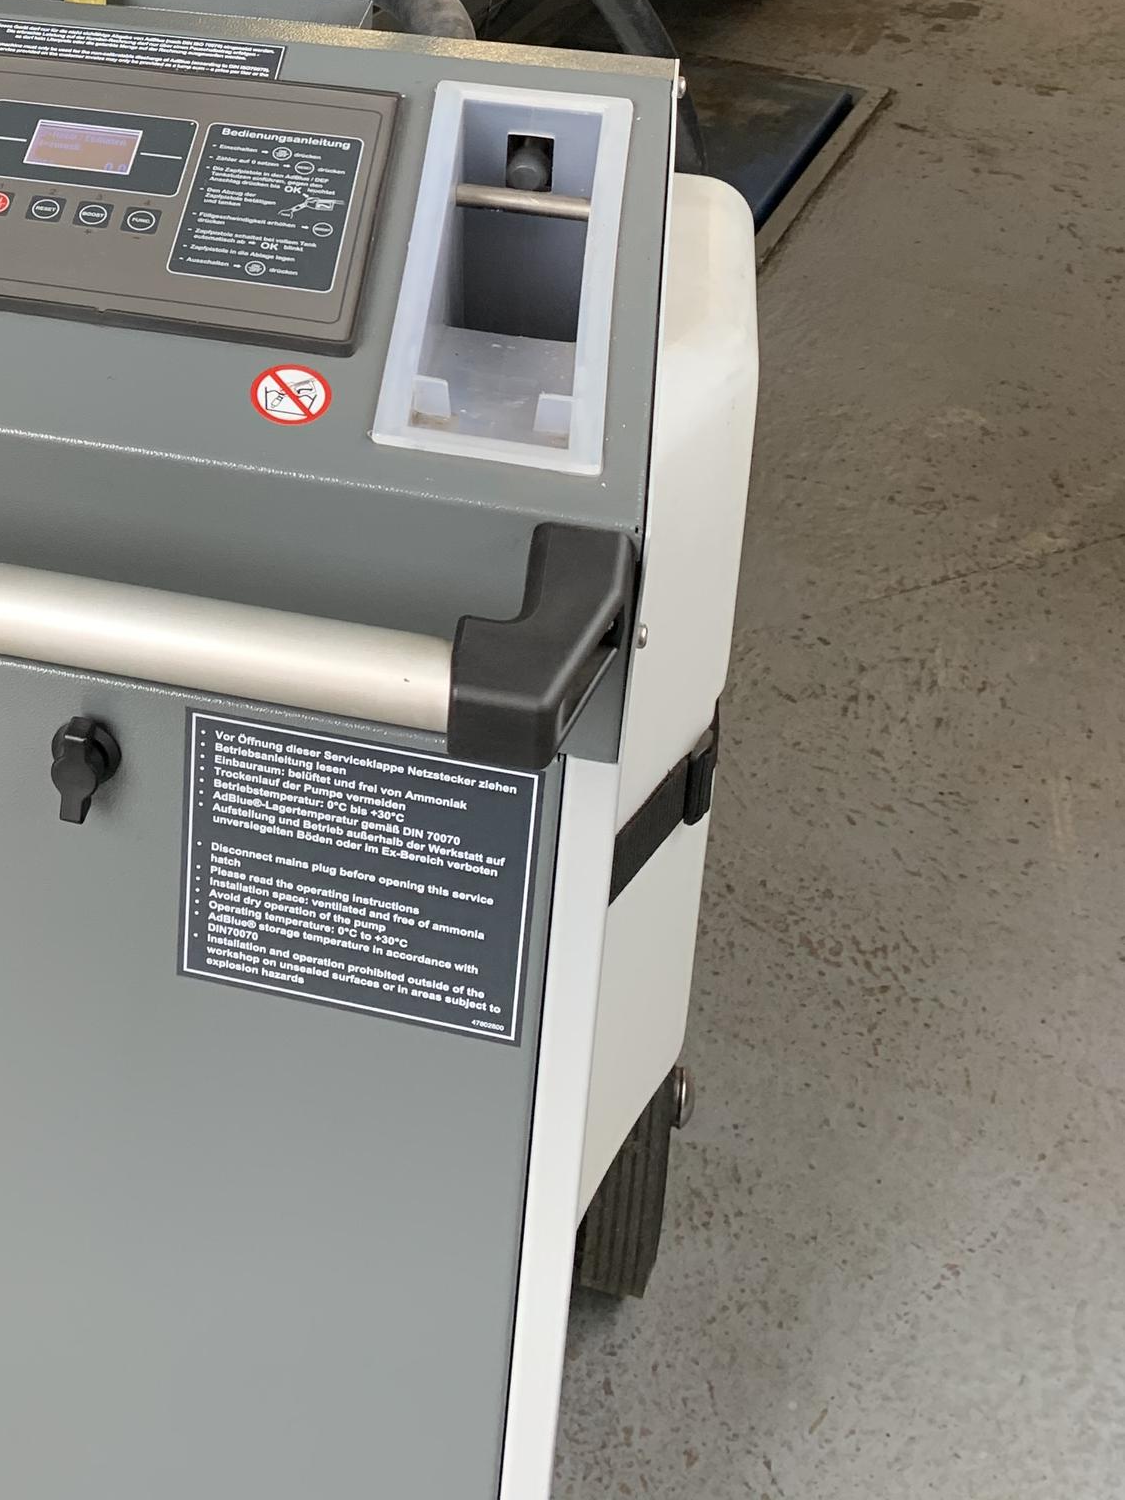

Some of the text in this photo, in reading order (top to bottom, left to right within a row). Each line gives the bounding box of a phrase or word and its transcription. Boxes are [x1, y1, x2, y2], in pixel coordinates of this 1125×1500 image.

[220, 127, 351, 150] Bedienungsanleitung
[214, 754, 467, 810] Einbauraum: belüftet und frei von Ammoniak
[215, 742, 346, 775] Betriebsanleitung lesen
[215, 729, 517, 794] Vor Öffnung dieser Serviceklappe Netzstecker ziehen
[213, 766, 405, 811] Trockenlauf der Pumpe vermeiden
[213, 778, 323, 809] Betriebstemperatur:
[350, 804, 367, 816] bis
[212, 801, 505, 867] Aufstellung und Betrieb außerhalb der Werkstatt auf
[212, 812, 498, 877] unversiegelten Böden oder im Ex-Bereich verboten
[361, 818, 399, 836] gemäß
[402, 826, 423, 838] DIN
[426, 830, 460, 846] 70070
[210, 853, 240, 867] hatch
[211, 841, 493, 905] Disconnect mains plug before opening this service
[208, 887, 386, 934] Avoid dry operation of the pump
[209, 876, 484, 940] Installation space: ventilated and free of ammonia
[210, 864, 419, 915] Please read the operating instructions
[207, 922, 258, 941] DIN70070
[208, 899, 262, 920] Operating
[264, 911, 334, 935] temperature:
[359, 930, 371, 941] to
[206, 955, 304, 984] explosion hazards
[207, 933, 484, 999] Installation and operation prohibited outside of the
[258, 921, 300, 939] storage
[302, 930, 369, 954] temperature
[372, 944, 383, 955] in
[385, 947, 451, 969] accordance
[453, 961, 478, 974] with
[206, 944, 501, 1014] workshop on unsealed surfaces or in areas subject to
